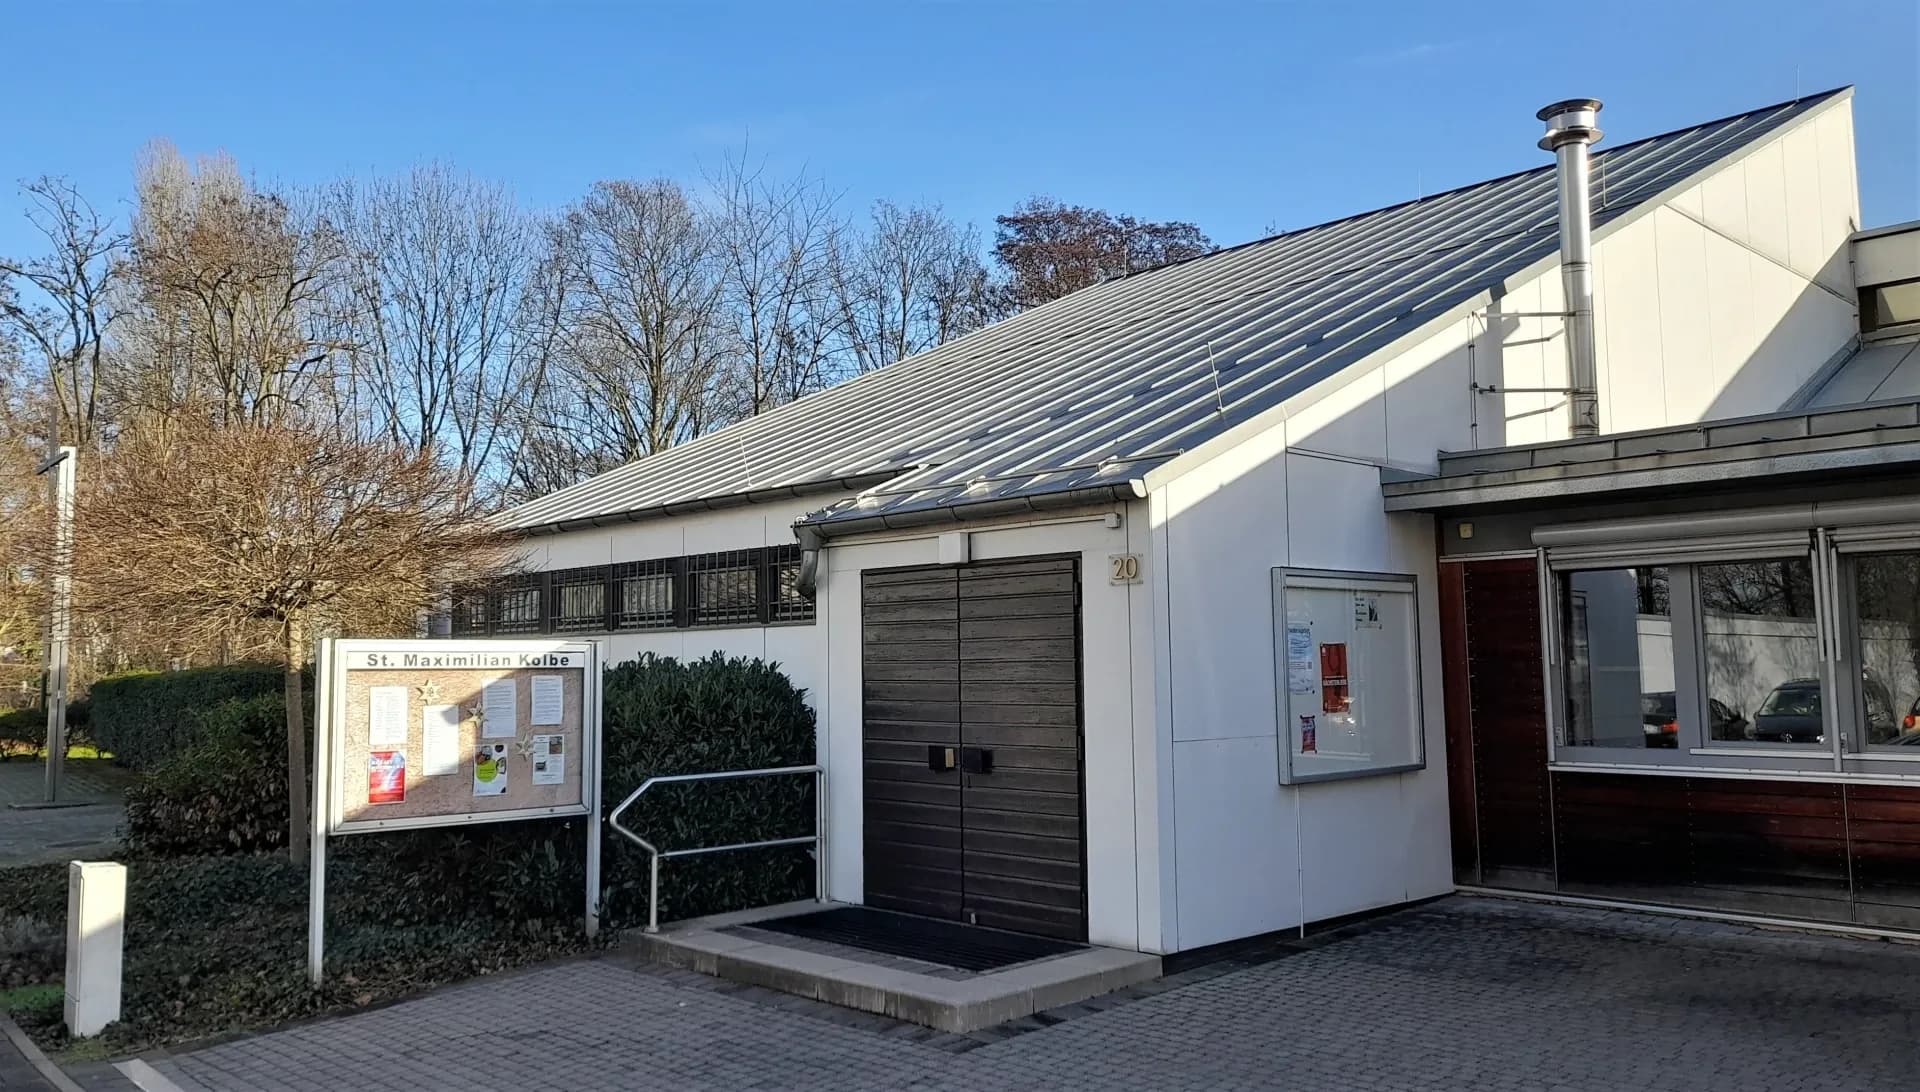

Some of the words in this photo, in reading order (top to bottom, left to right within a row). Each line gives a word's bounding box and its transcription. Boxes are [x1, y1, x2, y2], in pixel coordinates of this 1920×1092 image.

[1112, 556, 1137, 580] 20
[367, 653, 395, 667] St.
[403, 653, 511, 667] Maximilian
[519, 653, 570, 666] Kolbe
